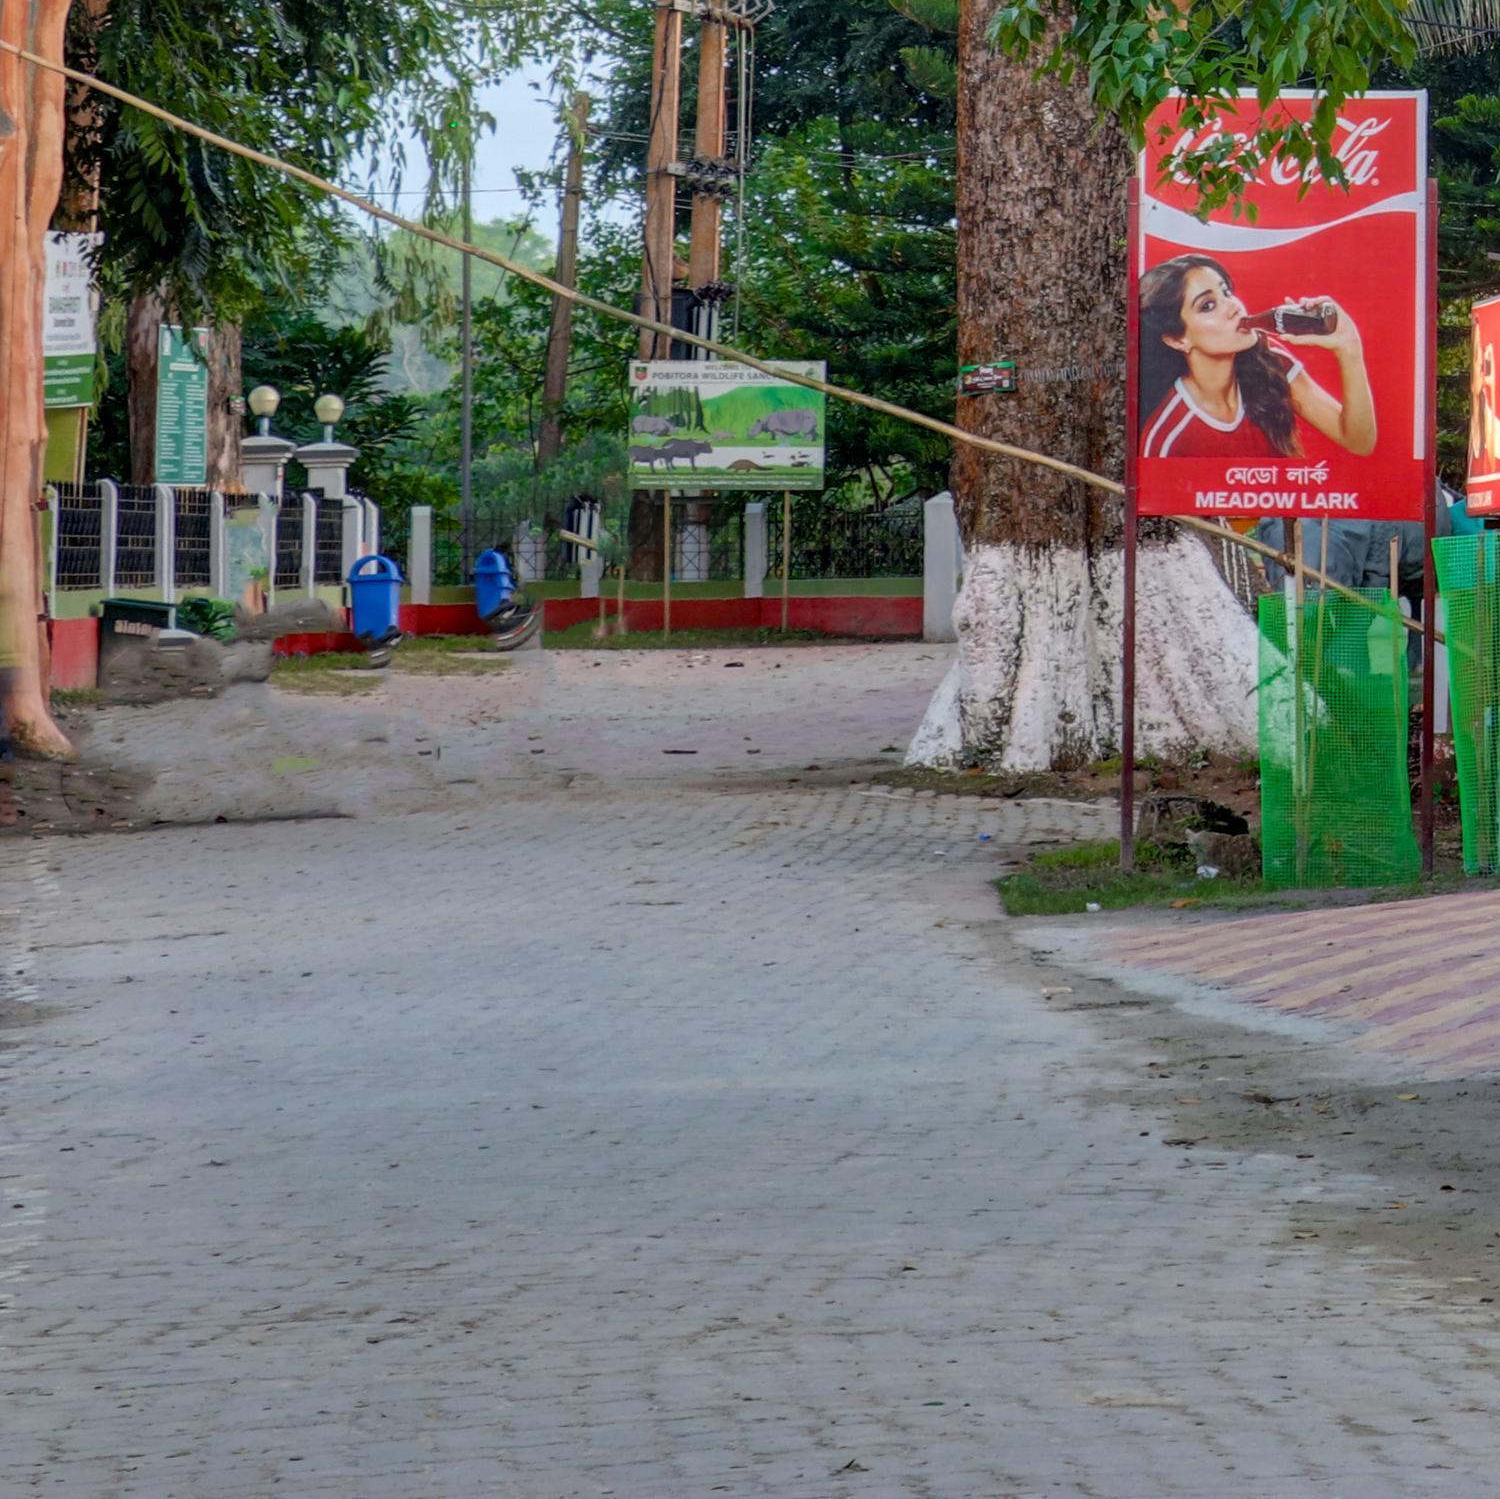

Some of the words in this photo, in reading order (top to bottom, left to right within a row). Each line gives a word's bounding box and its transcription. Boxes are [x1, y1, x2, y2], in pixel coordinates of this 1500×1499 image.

[652, 372, 699, 381] POBITORA
[701, 372, 745, 381] WILDLIFE
[1225, 465, 1278, 486] মেডো
[1285, 460, 1330, 486] লার্ক
[1195, 491, 1296, 509] MEADOW
[1301, 491, 1359, 510] LARK
